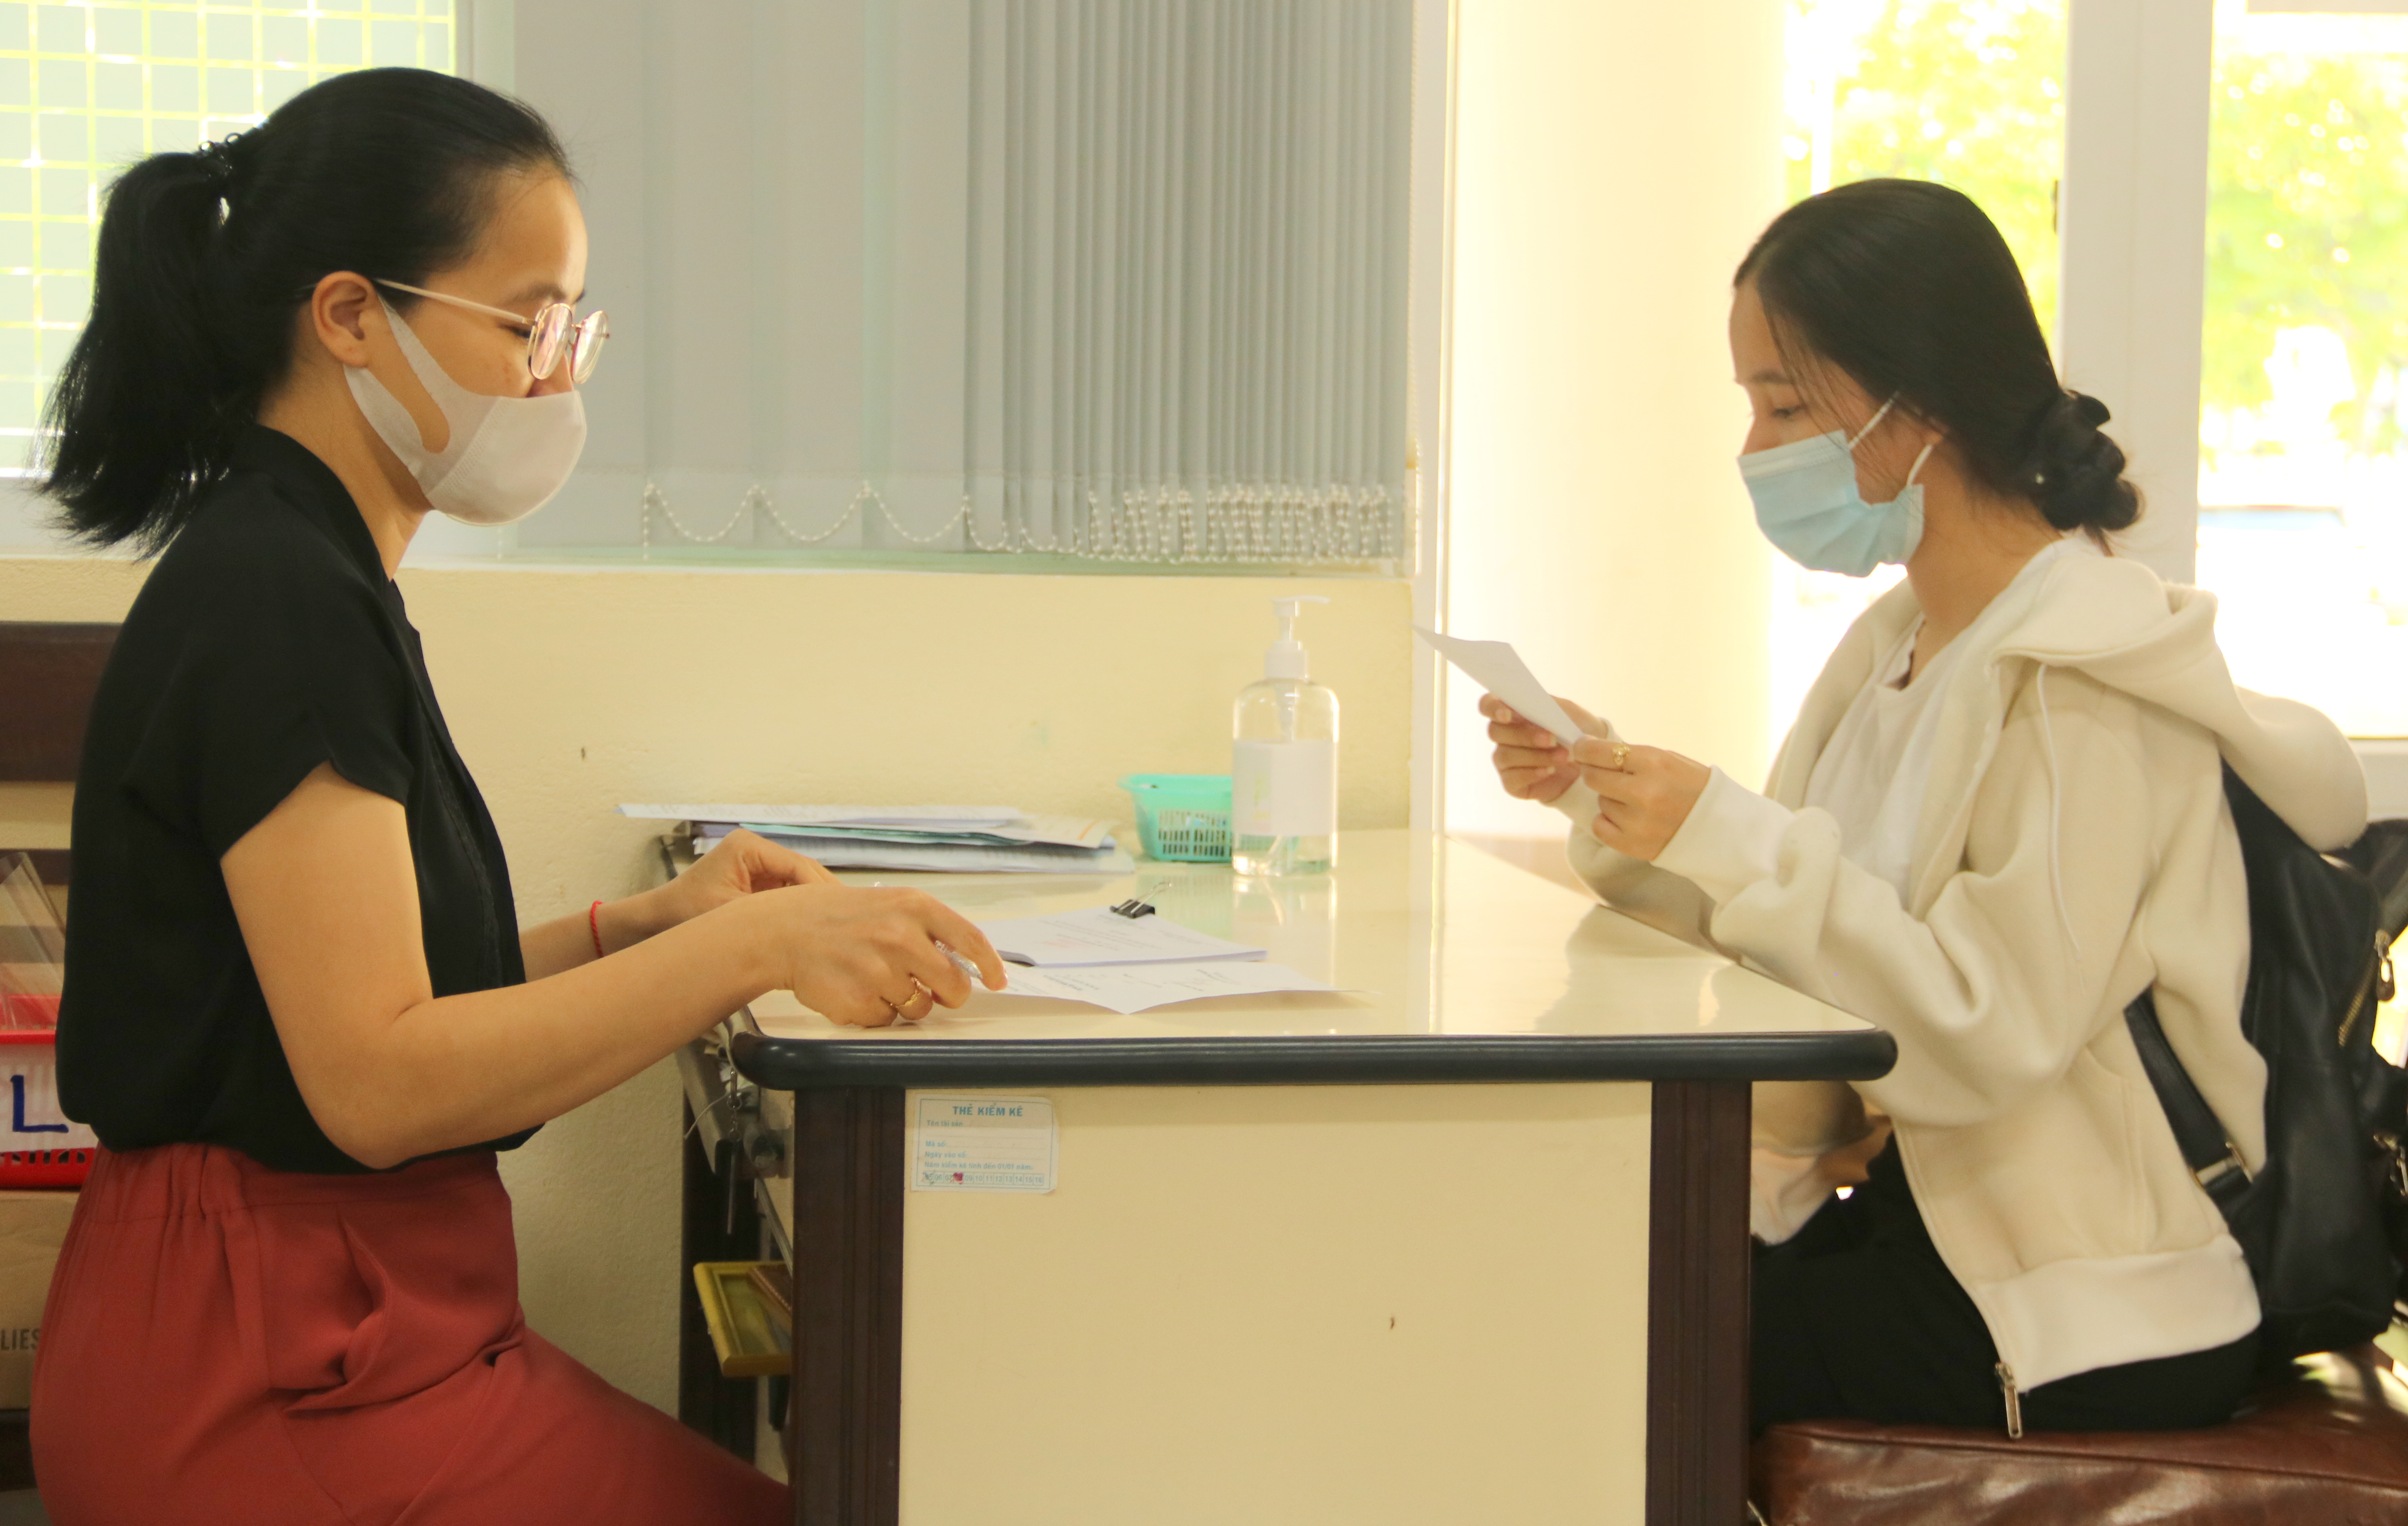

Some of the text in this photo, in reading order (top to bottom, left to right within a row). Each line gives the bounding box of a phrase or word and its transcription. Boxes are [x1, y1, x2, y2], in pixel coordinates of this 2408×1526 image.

[10, 1075, 69, 1133] L
[953, 1102, 1023, 1116] THẺ KIỂM KÊ
